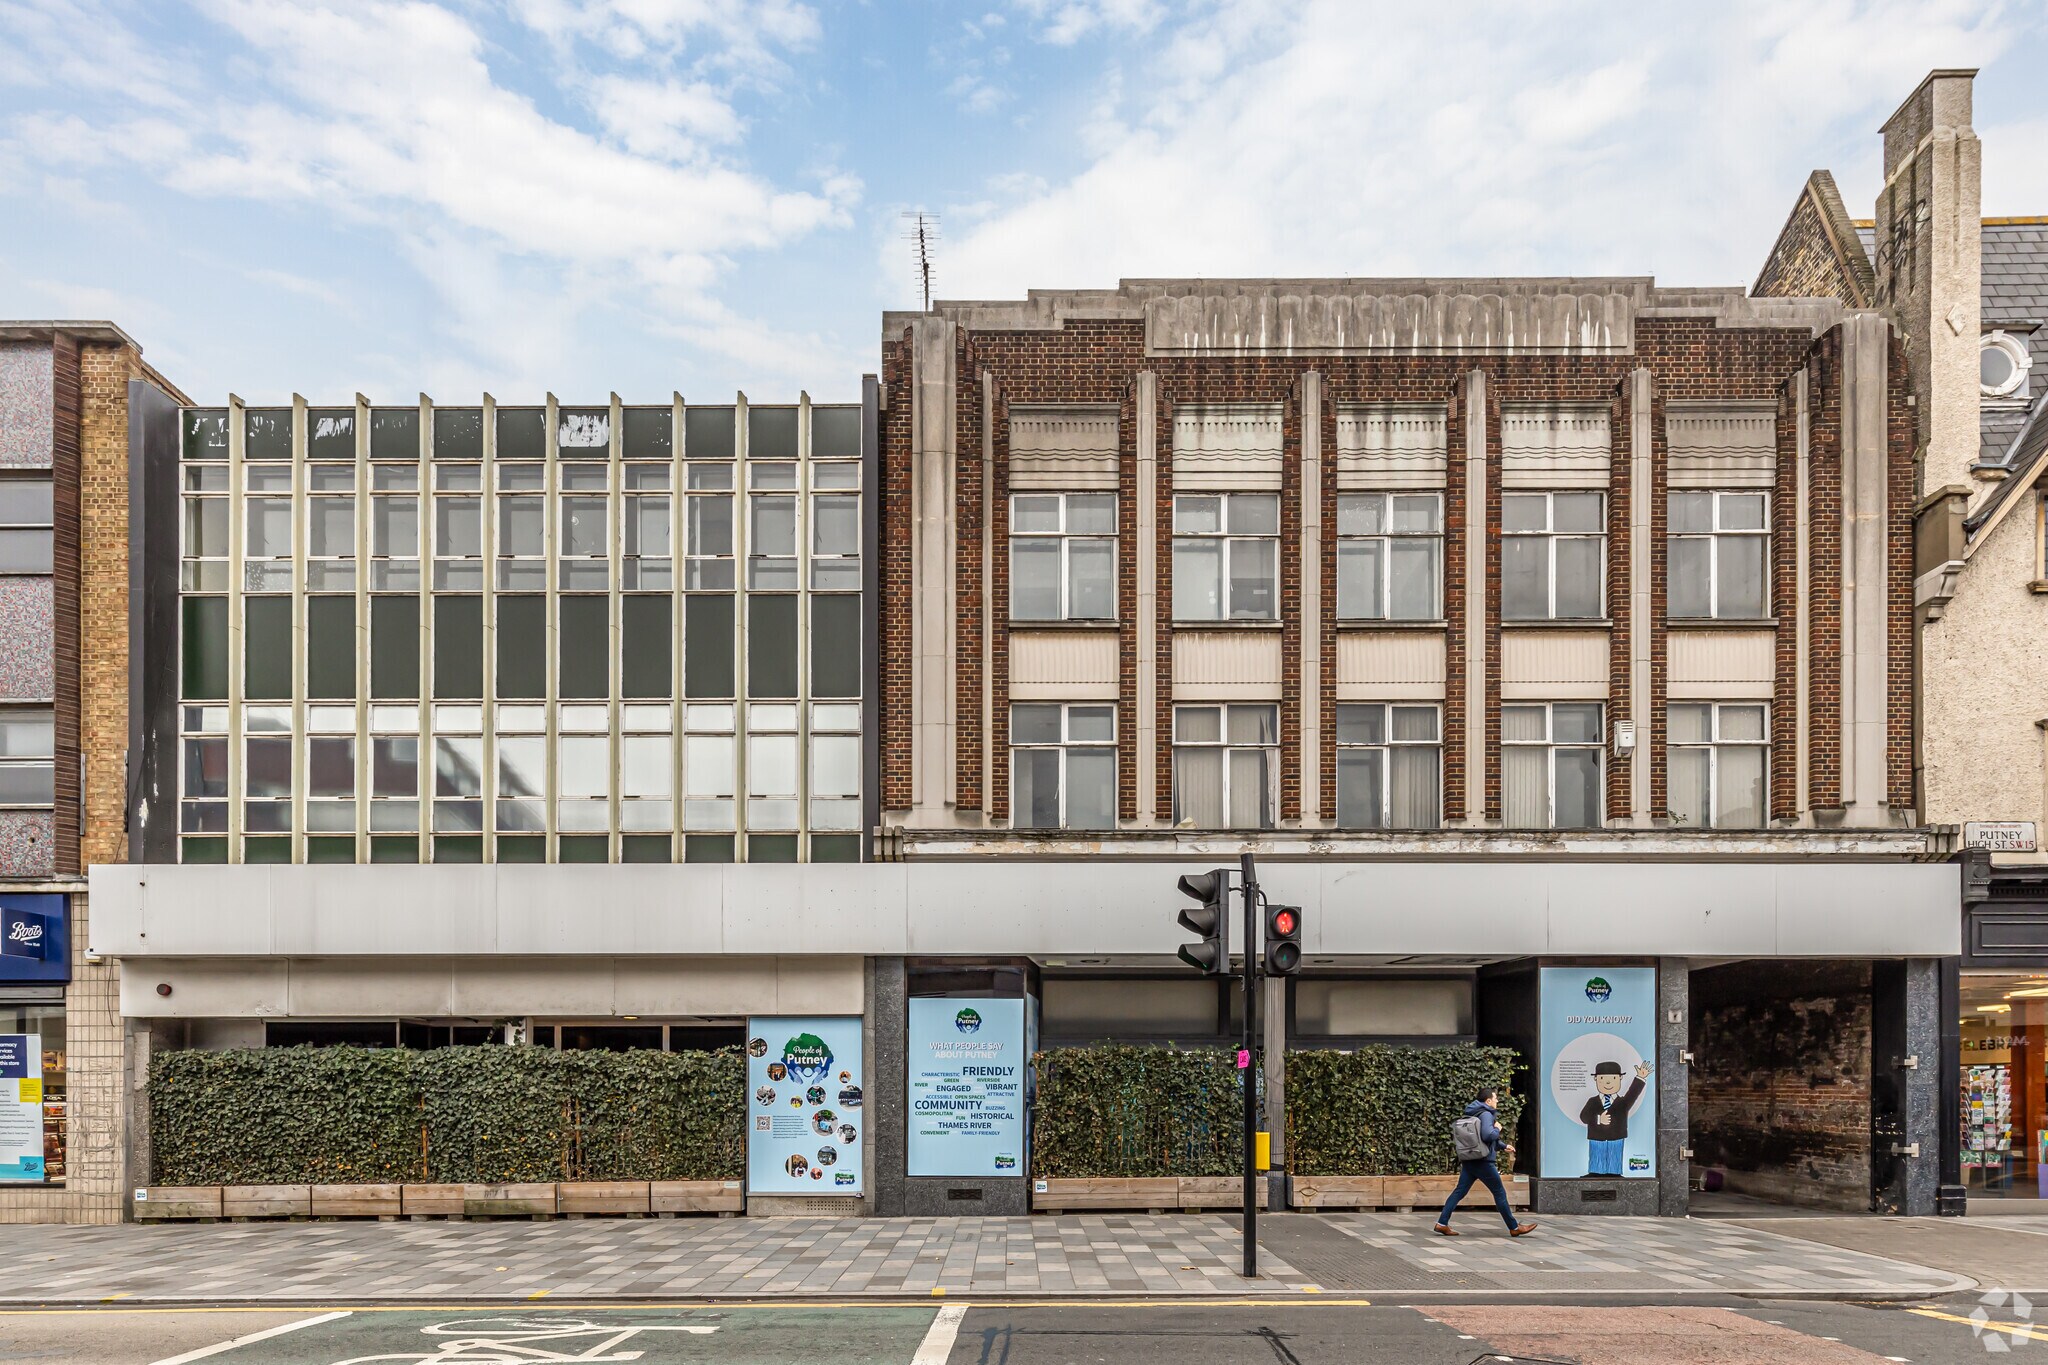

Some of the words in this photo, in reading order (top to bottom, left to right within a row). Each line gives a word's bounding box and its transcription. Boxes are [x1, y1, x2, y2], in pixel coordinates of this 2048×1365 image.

[1980, 831, 2022, 840] PUTNEY
[1968, 841, 1991, 849] HIGH
[1995, 841, 2008, 849] ST.
[9, 921, 43, 942] Boots
[1566, 1015, 1582, 1024] DID
[1583, 1015, 1601, 1024] YOU
[1602, 1015, 1633, 1024] KNOW?
[929, 1042, 955, 1051] WHAT
[955, 1042, 988, 1051] PEOPLE
[988, 1042, 1004, 1051] SAY
[1960, 1039, 2012, 1051] ELEBRA
[793, 1046, 815, 1056] People
[815, 1046, 822, 1056] of
[934, 1051, 964, 1059] ABOUT
[965, 1051, 998, 1059] PUTNEY
[787, 1053, 828, 1067] Putney
[962, 1066, 1015, 1076] FRIENDLY
[915, 1100, 983, 1110] COMMUNITY
[970, 1112, 1015, 1120] HISTORICAL
